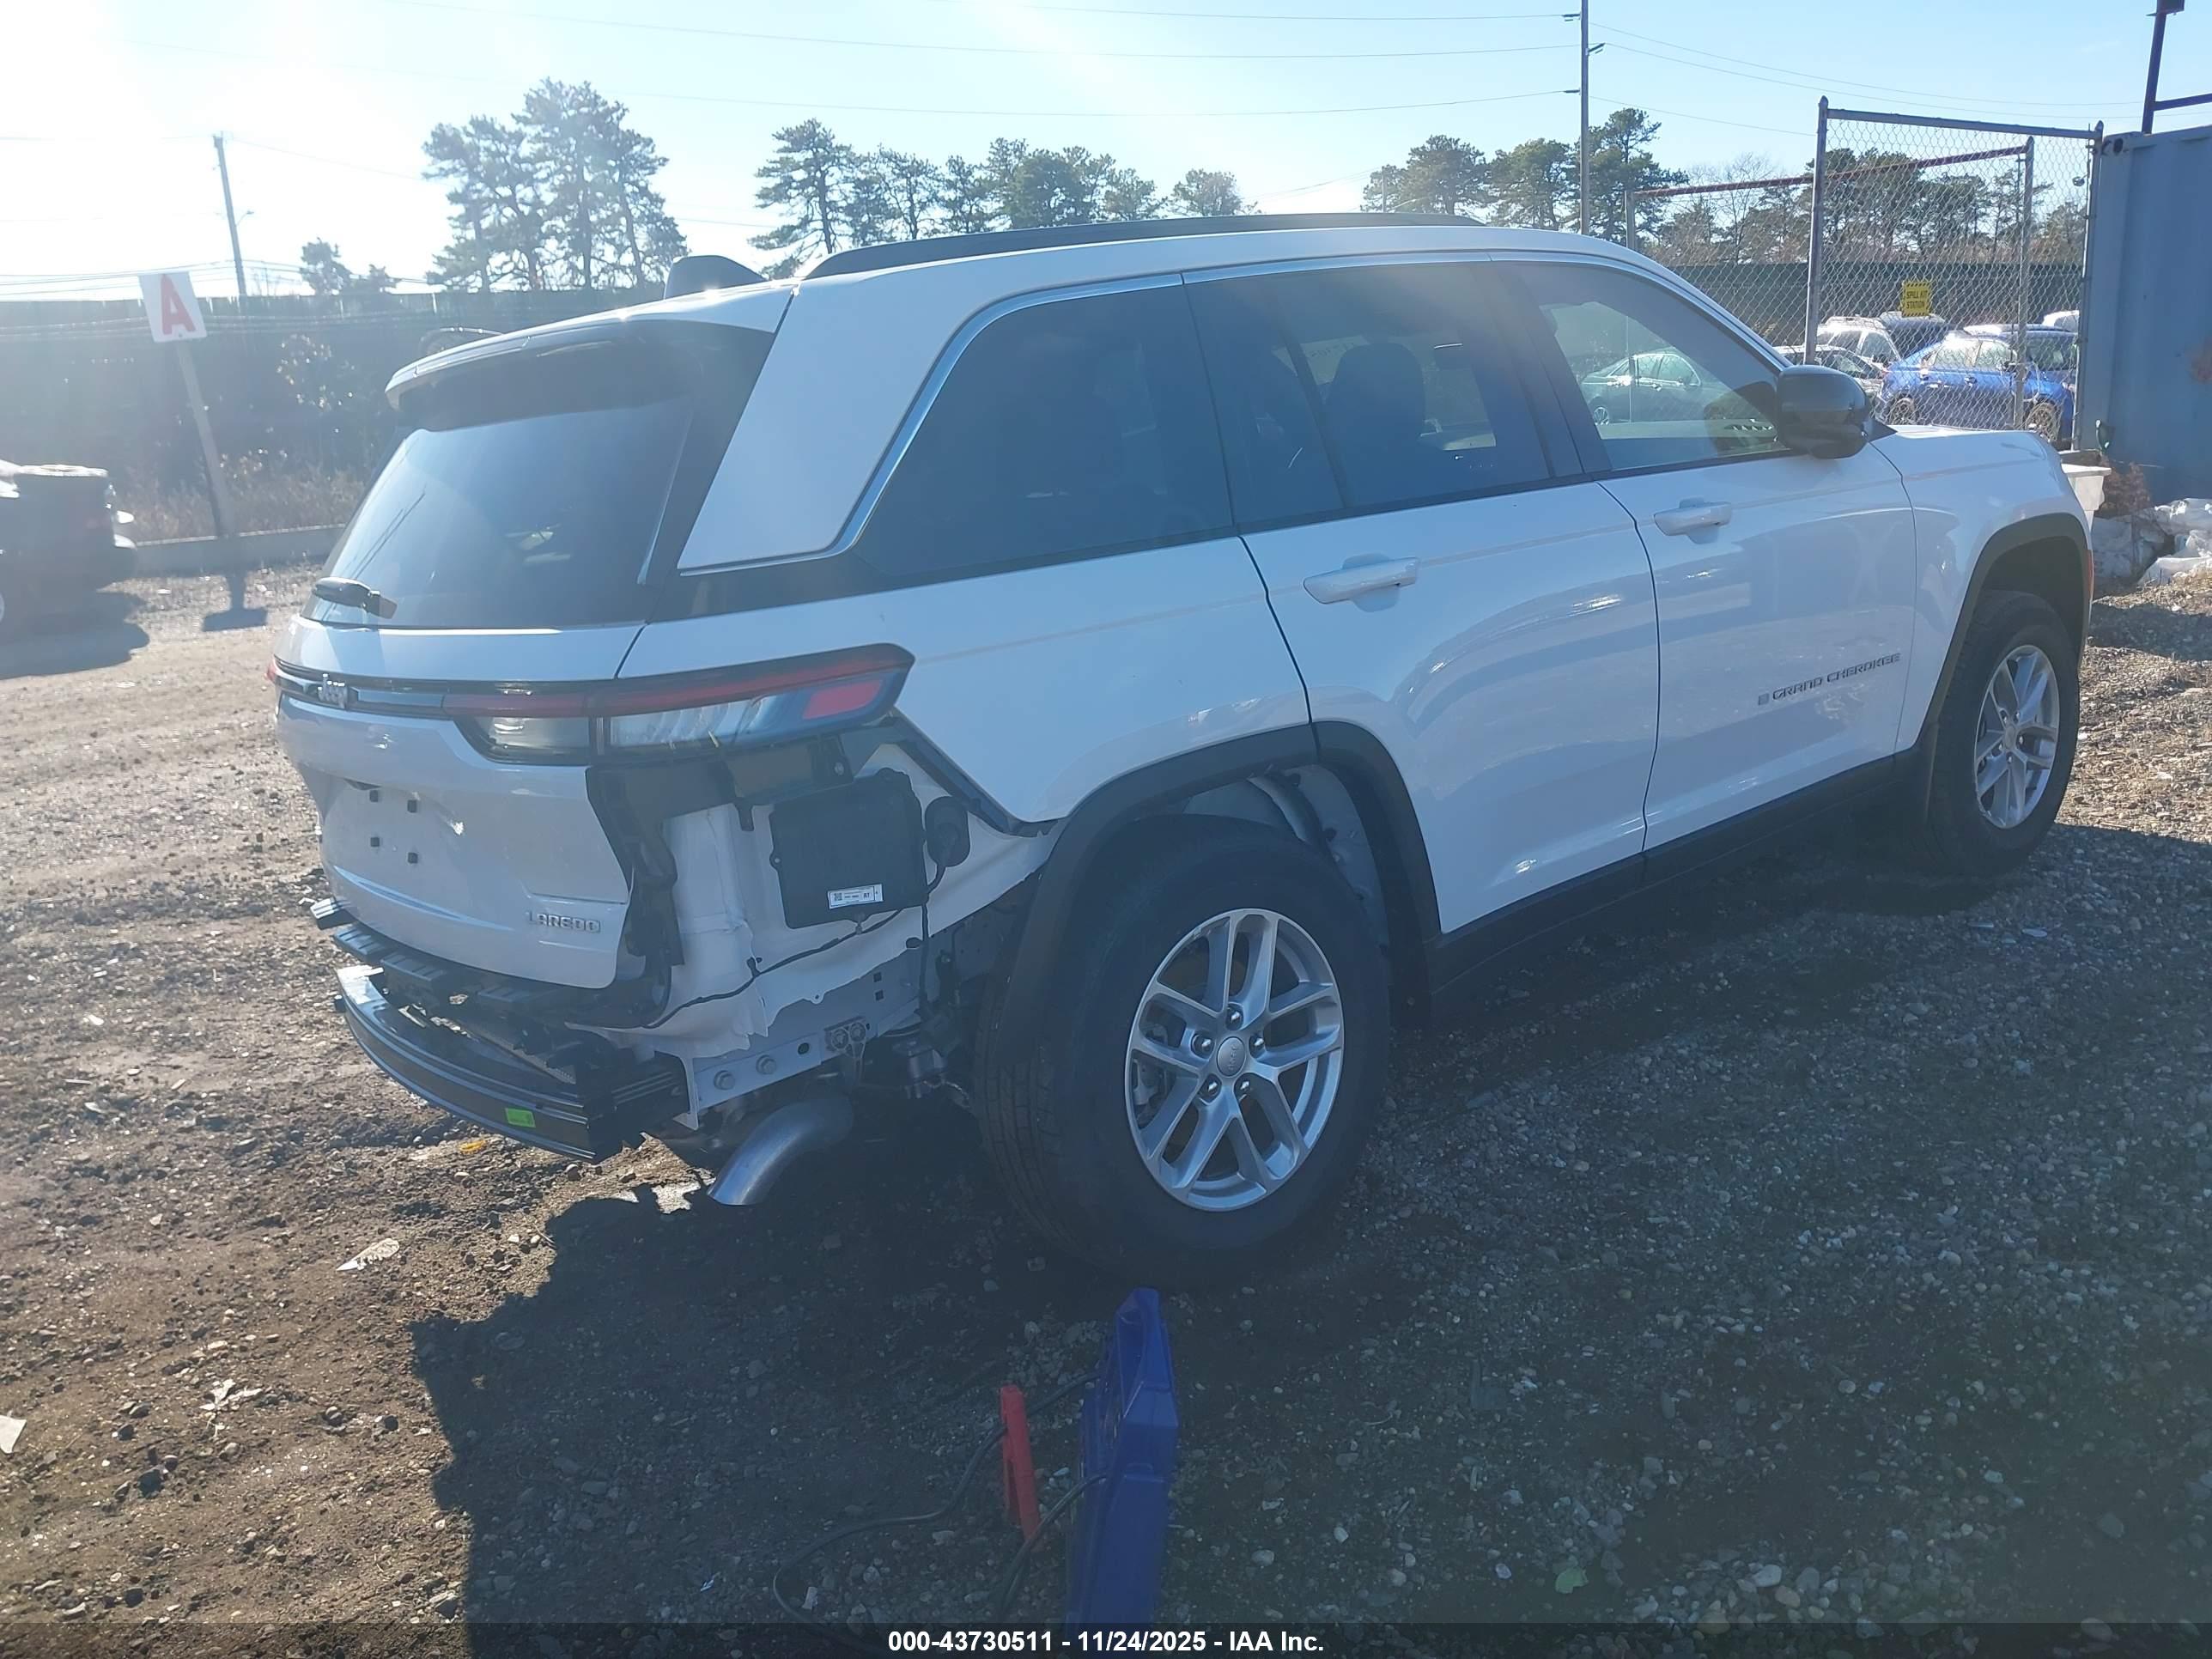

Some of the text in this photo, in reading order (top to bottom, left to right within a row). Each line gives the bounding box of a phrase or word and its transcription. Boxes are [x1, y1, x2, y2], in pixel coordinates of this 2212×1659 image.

[161, 274, 197, 335] A
[317, 673, 348, 709] Jeep
[1772, 653, 1901, 700] GRAND CHEROKEE
[526, 911, 601, 933] LAREDO
